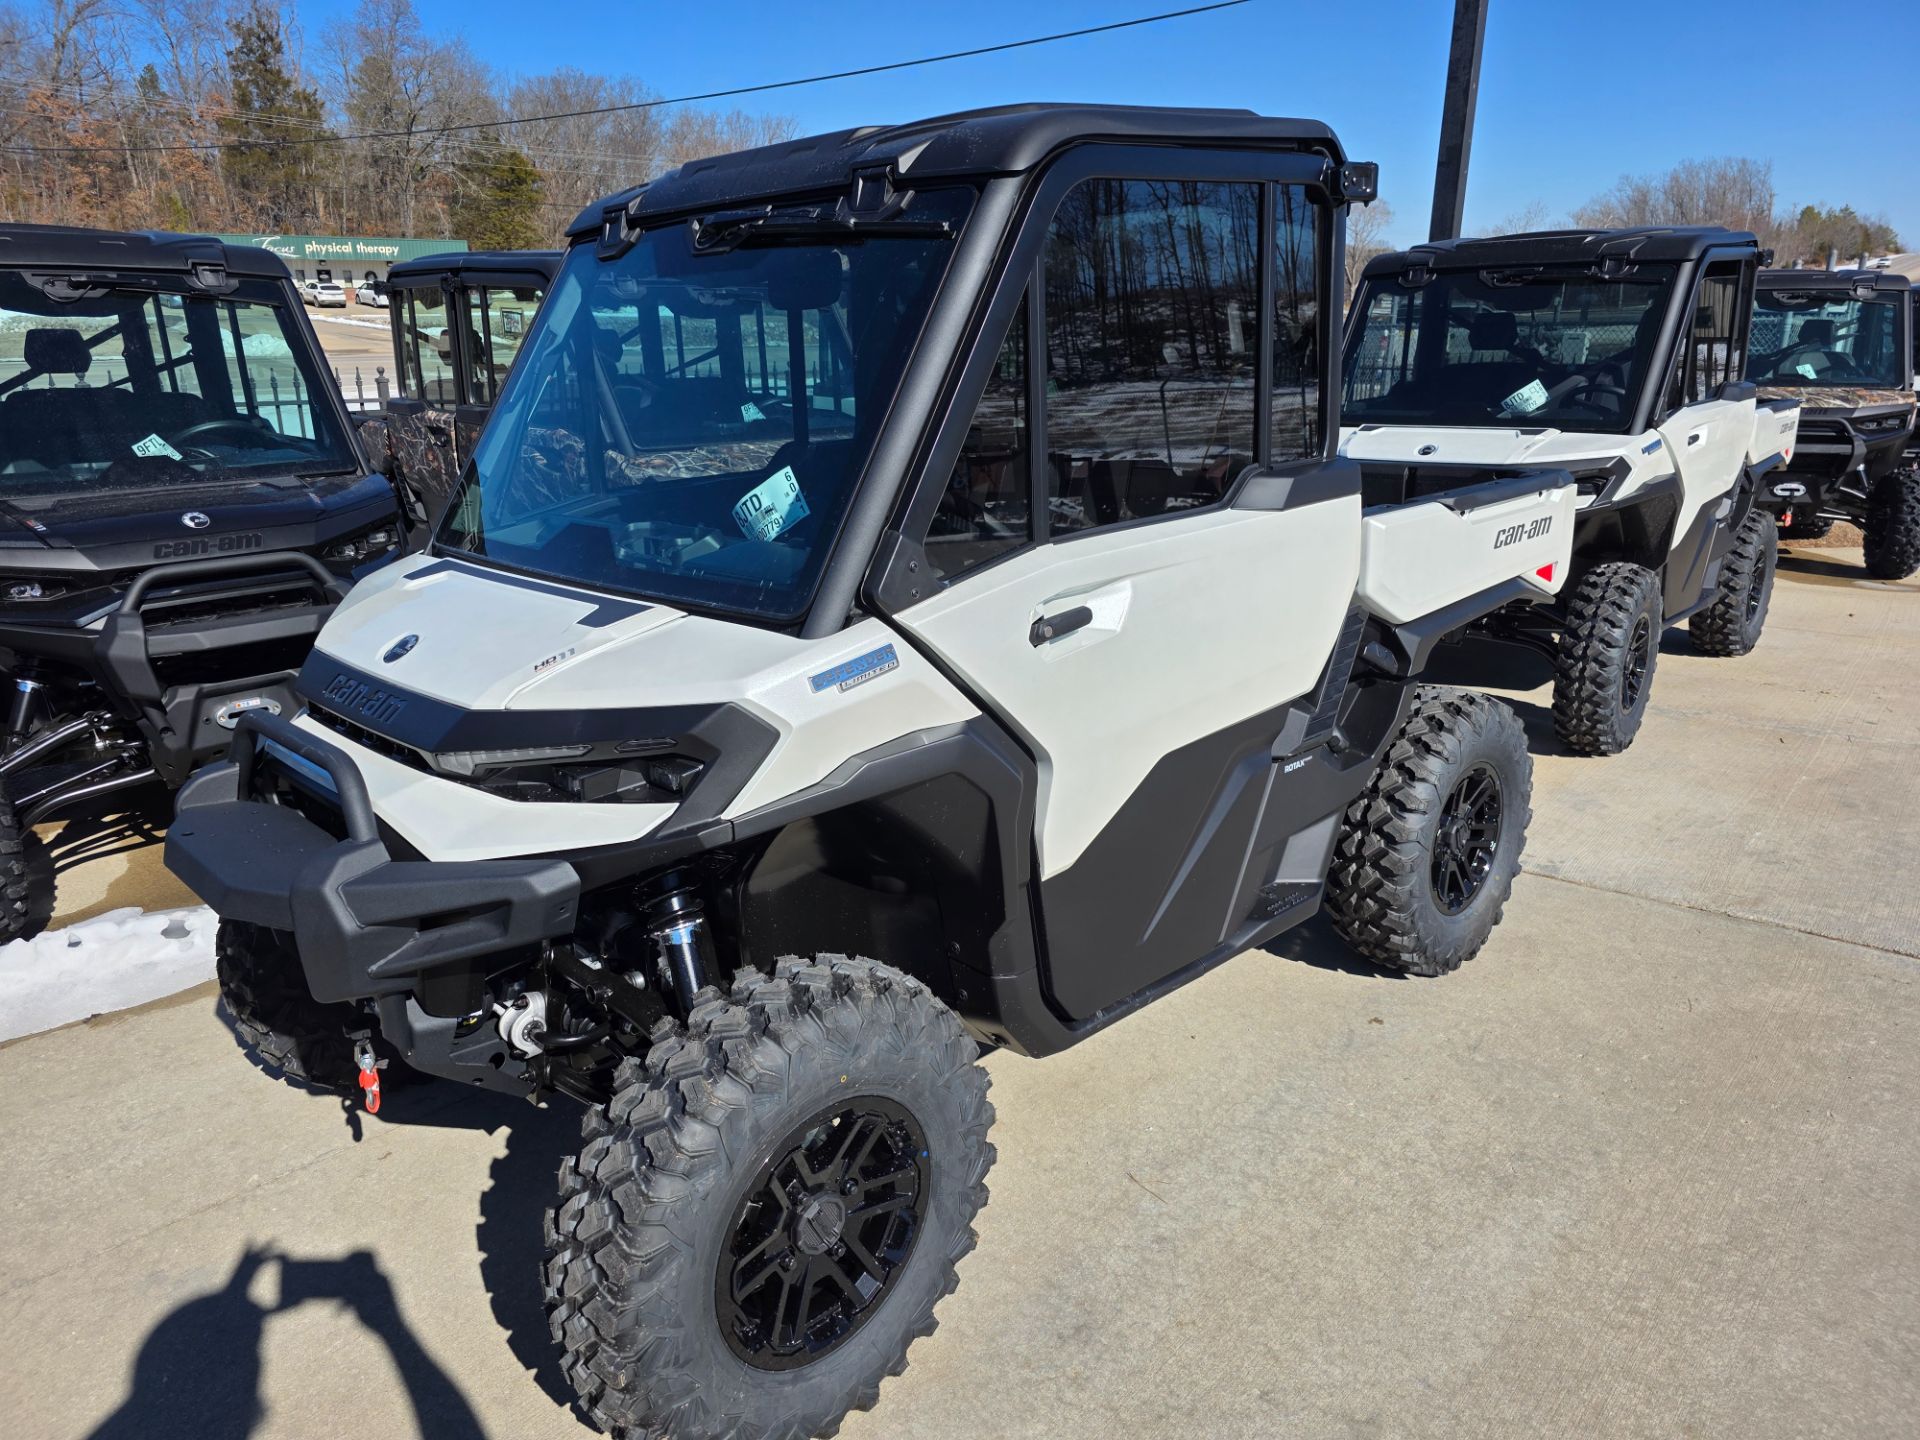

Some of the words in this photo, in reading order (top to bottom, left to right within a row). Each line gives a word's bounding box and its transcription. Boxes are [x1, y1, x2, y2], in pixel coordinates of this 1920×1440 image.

[305, 240, 353, 255] physical
[356, 242, 399, 256] therapy
[153, 532, 265, 560] can-am
[1493, 515, 1553, 550] can-am
[322, 673, 408, 725] can-am
[1284, 759, 1305, 774] ROTAX
